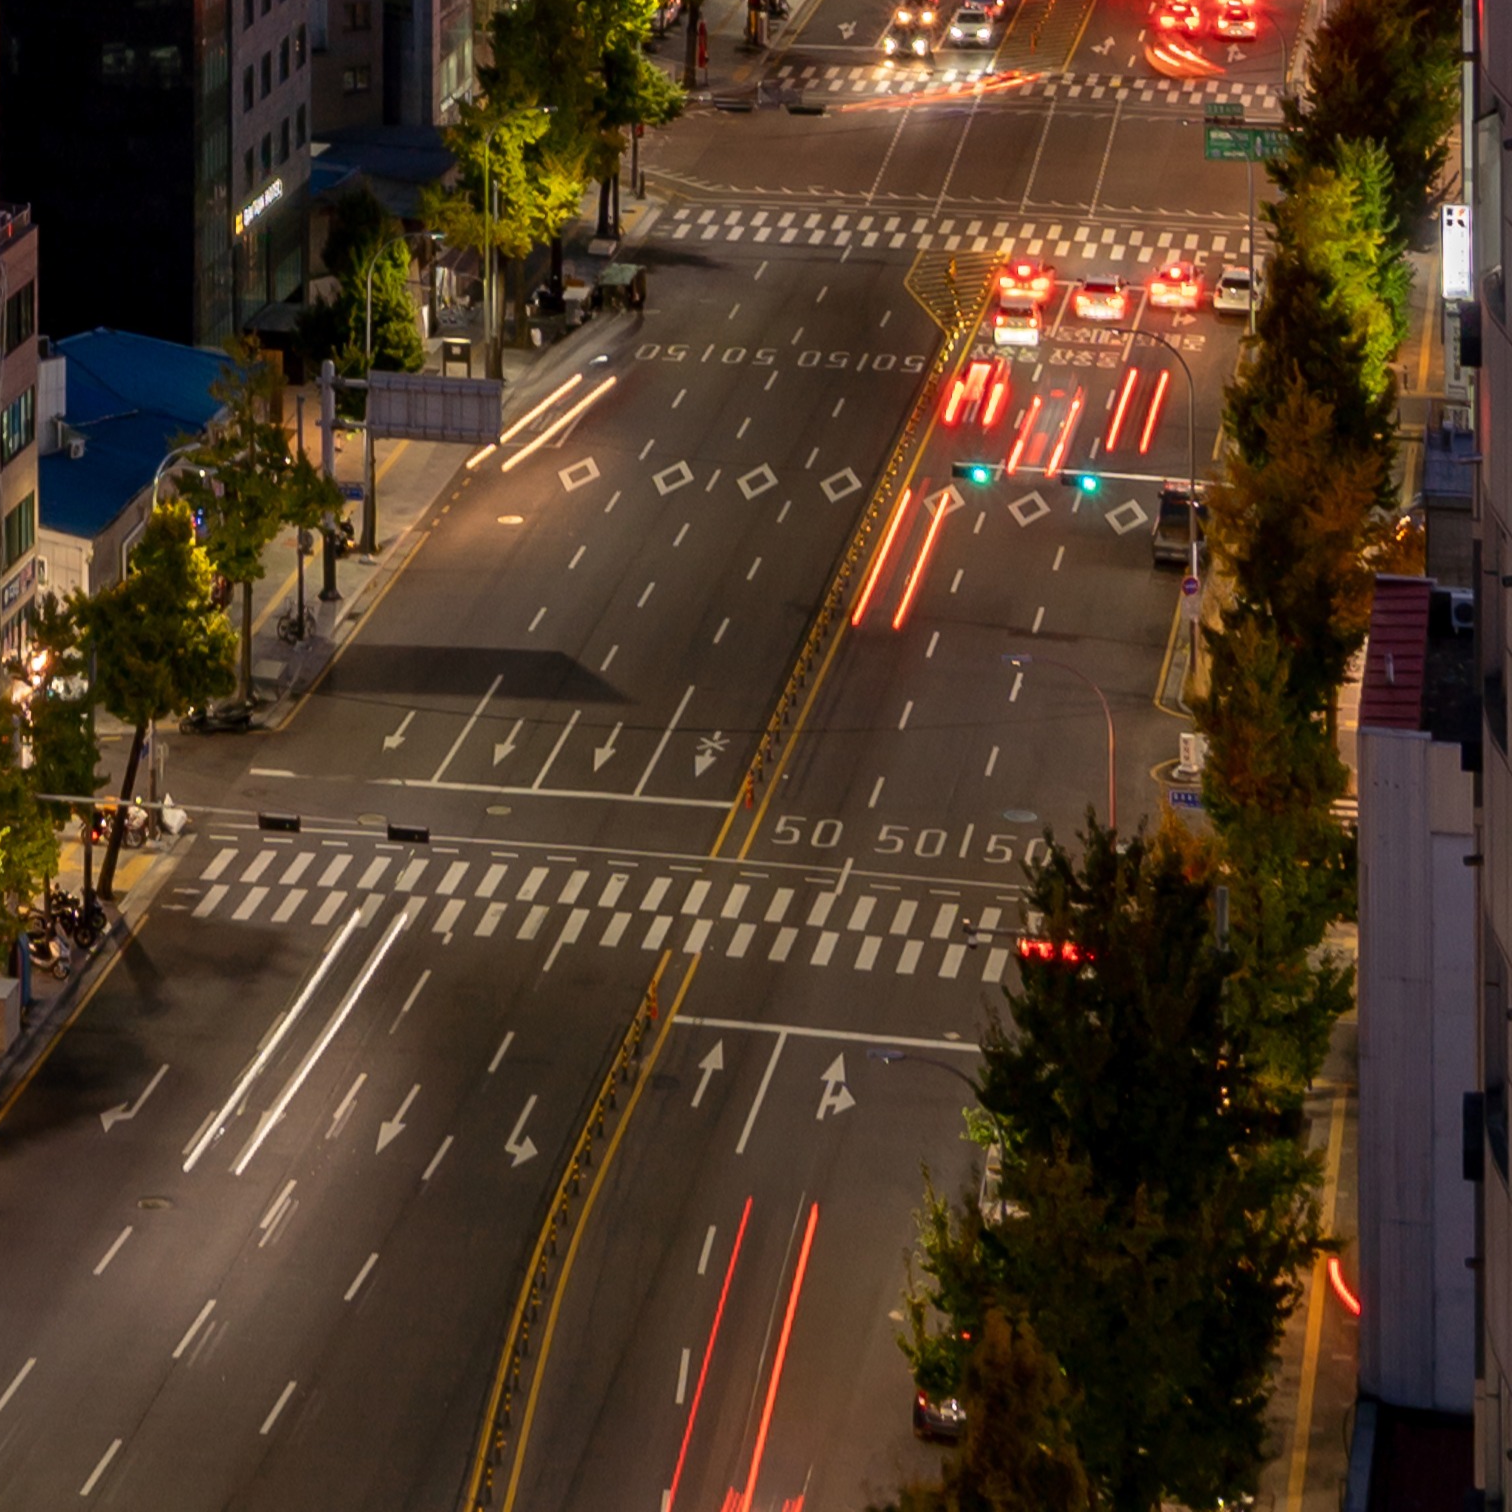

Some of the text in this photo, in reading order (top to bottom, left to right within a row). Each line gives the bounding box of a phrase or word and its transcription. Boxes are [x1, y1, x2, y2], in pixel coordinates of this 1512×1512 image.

[635, 343, 690, 363] 50
[721, 346, 778, 366] 50
[797, 350, 851, 369] 50
[871, 353, 926, 373] 50
[771, 815, 844, 848] 50
[874, 824, 948, 858] 50
[983, 834, 1055, 867] 50
